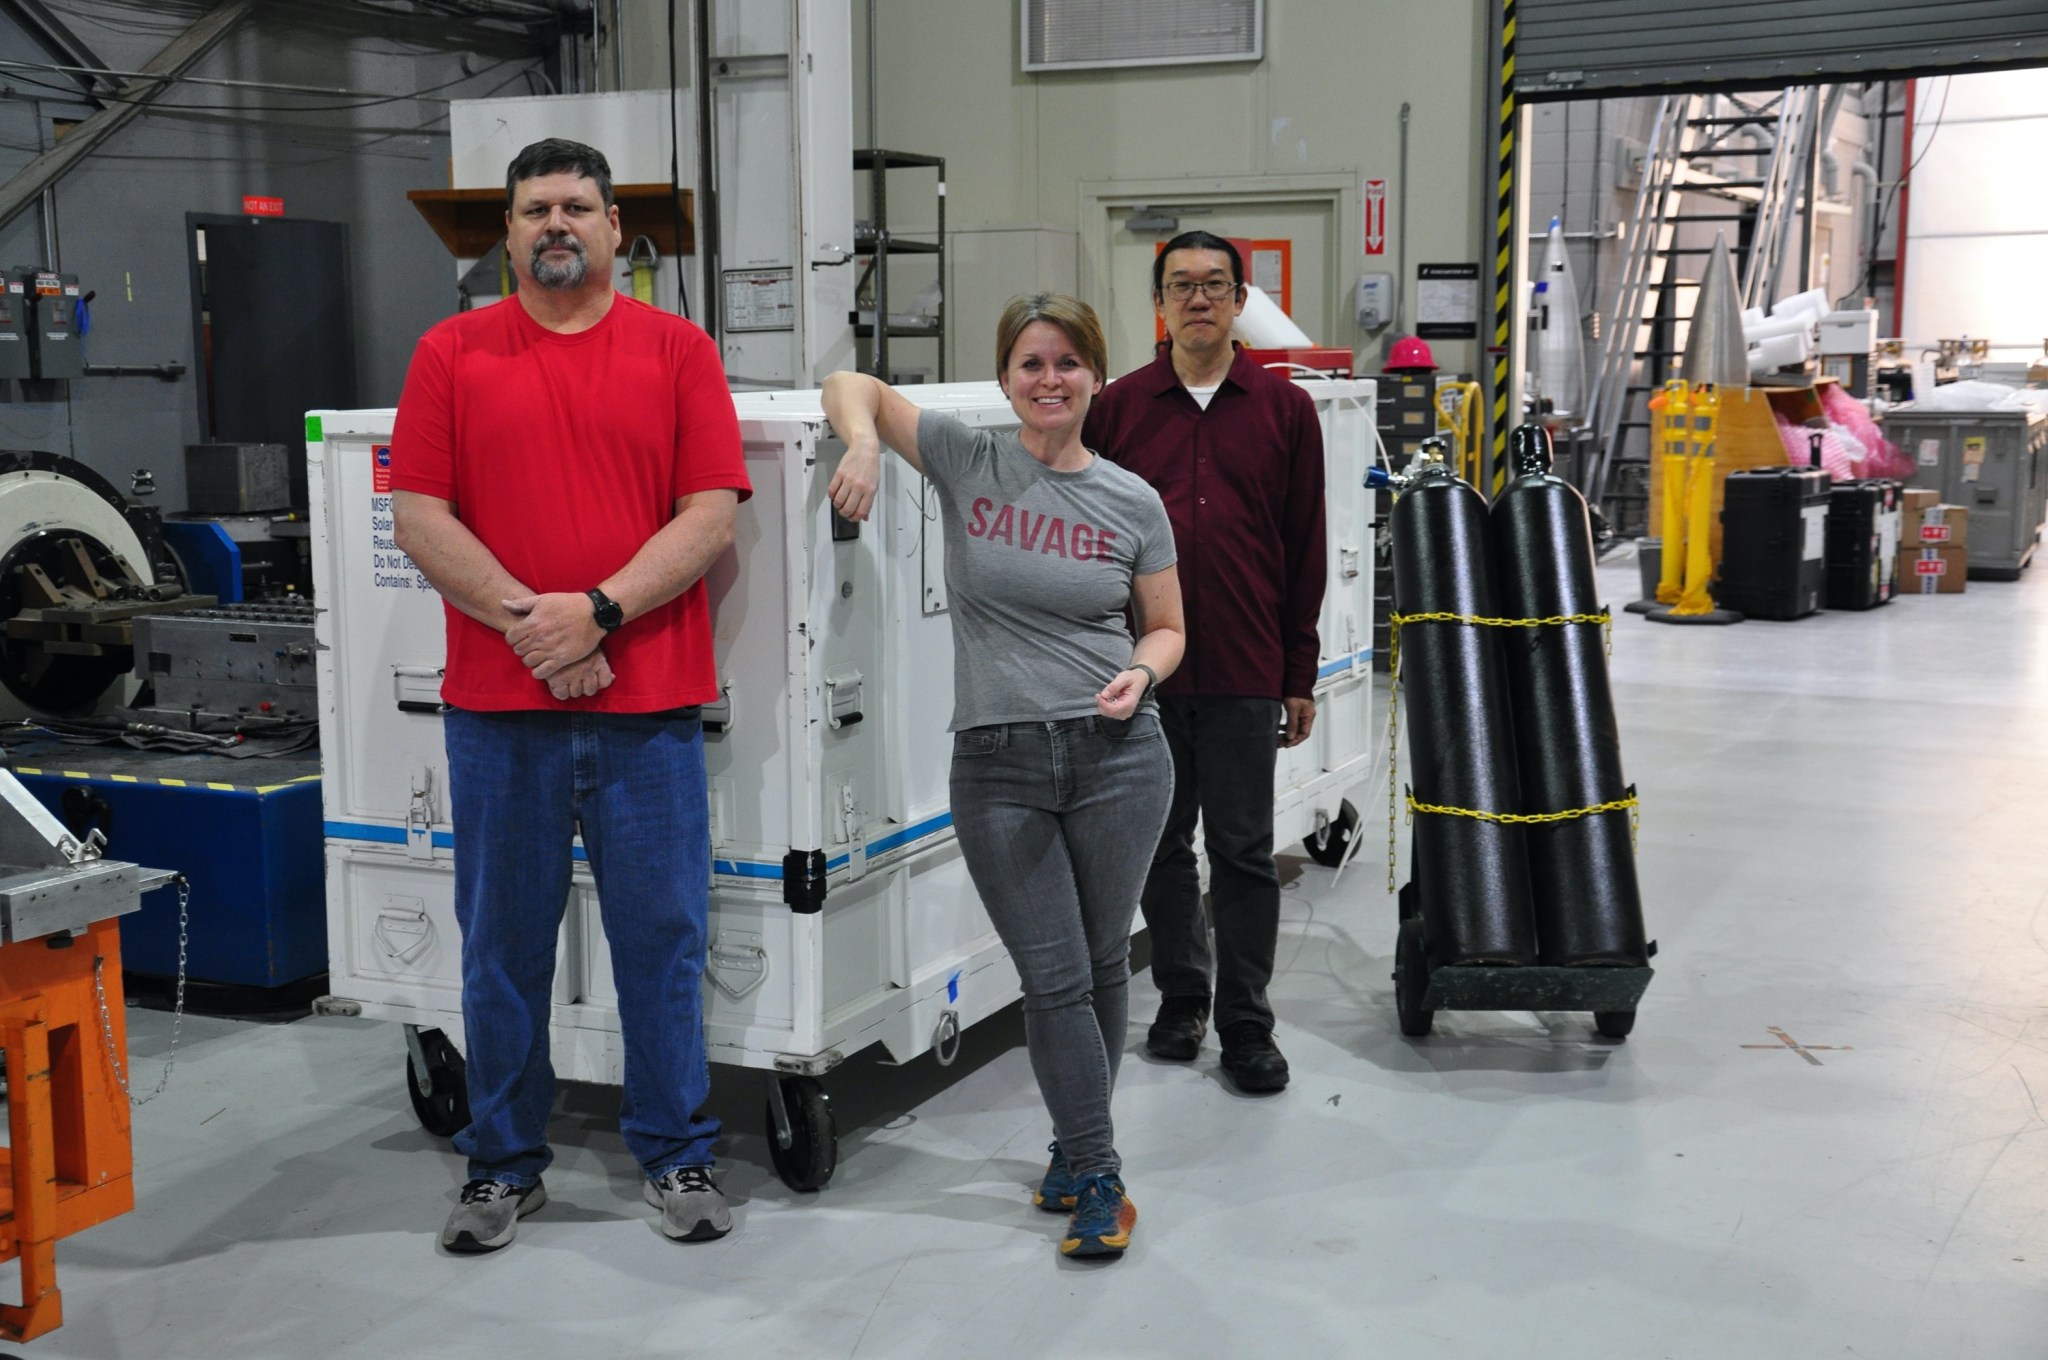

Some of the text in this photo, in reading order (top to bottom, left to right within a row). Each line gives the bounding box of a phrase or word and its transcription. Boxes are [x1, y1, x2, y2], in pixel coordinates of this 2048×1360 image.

[243, 200, 284, 212] NOT AN EXIT
[372, 515, 393, 531] Solar
[967, 496, 1118, 564] SAVAGE
[374, 553, 385, 569] Do
[387, 554, 401, 570] Not
[374, 572, 413, 589] Contains:
